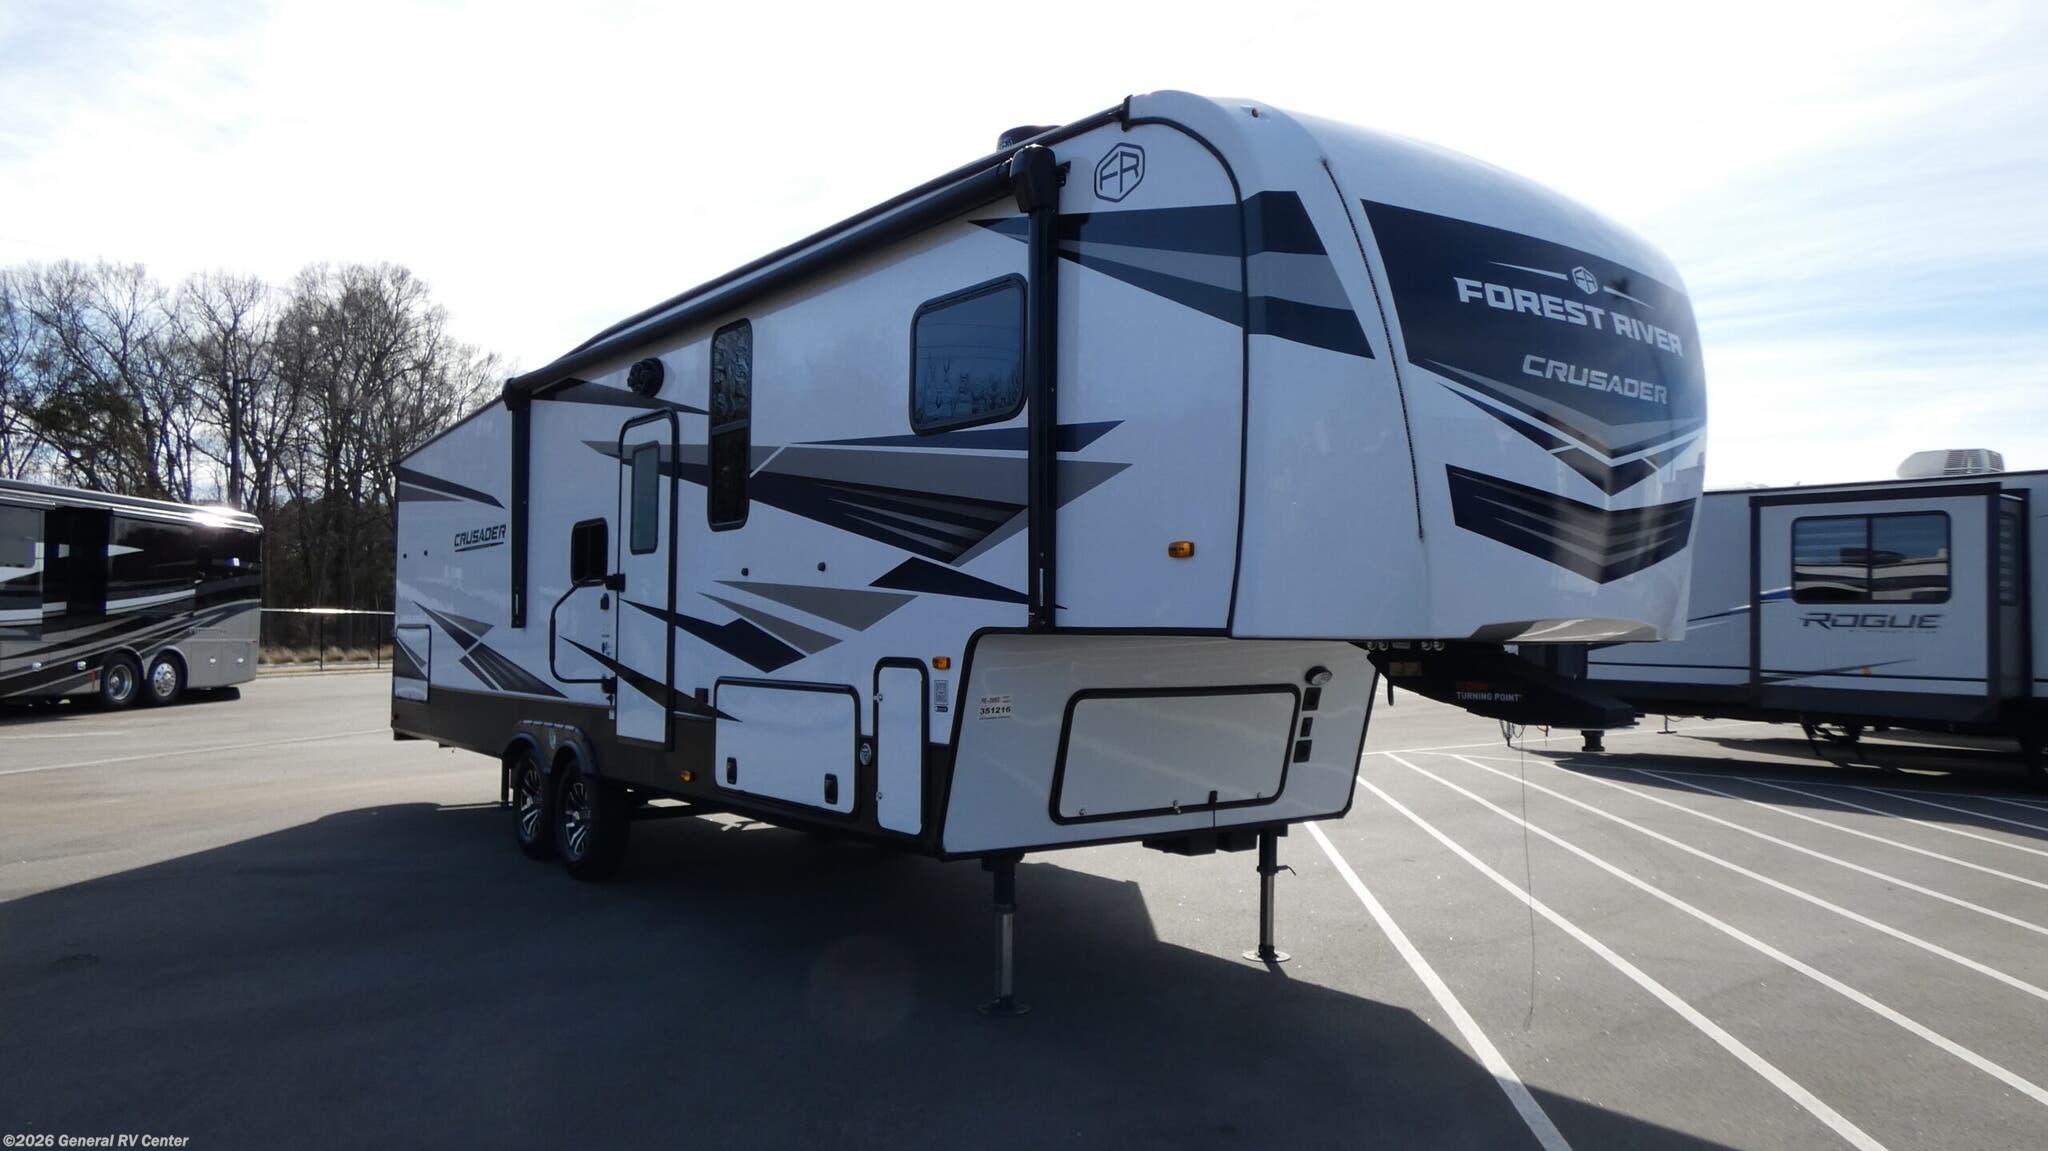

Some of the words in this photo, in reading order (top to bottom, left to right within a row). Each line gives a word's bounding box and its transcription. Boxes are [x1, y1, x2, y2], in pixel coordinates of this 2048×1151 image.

[1453, 277, 1605, 330] FOREST
[1611, 311, 1684, 357] RIVER
[1522, 354, 1668, 404] CRUSADER
[454, 524, 507, 547] CRUSADER
[1799, 612, 1943, 631] ROGUE
[1456, 691, 1493, 701] TURNING
[1494, 692, 1520, 702] POINT
[979, 706, 1011, 715] 351216
